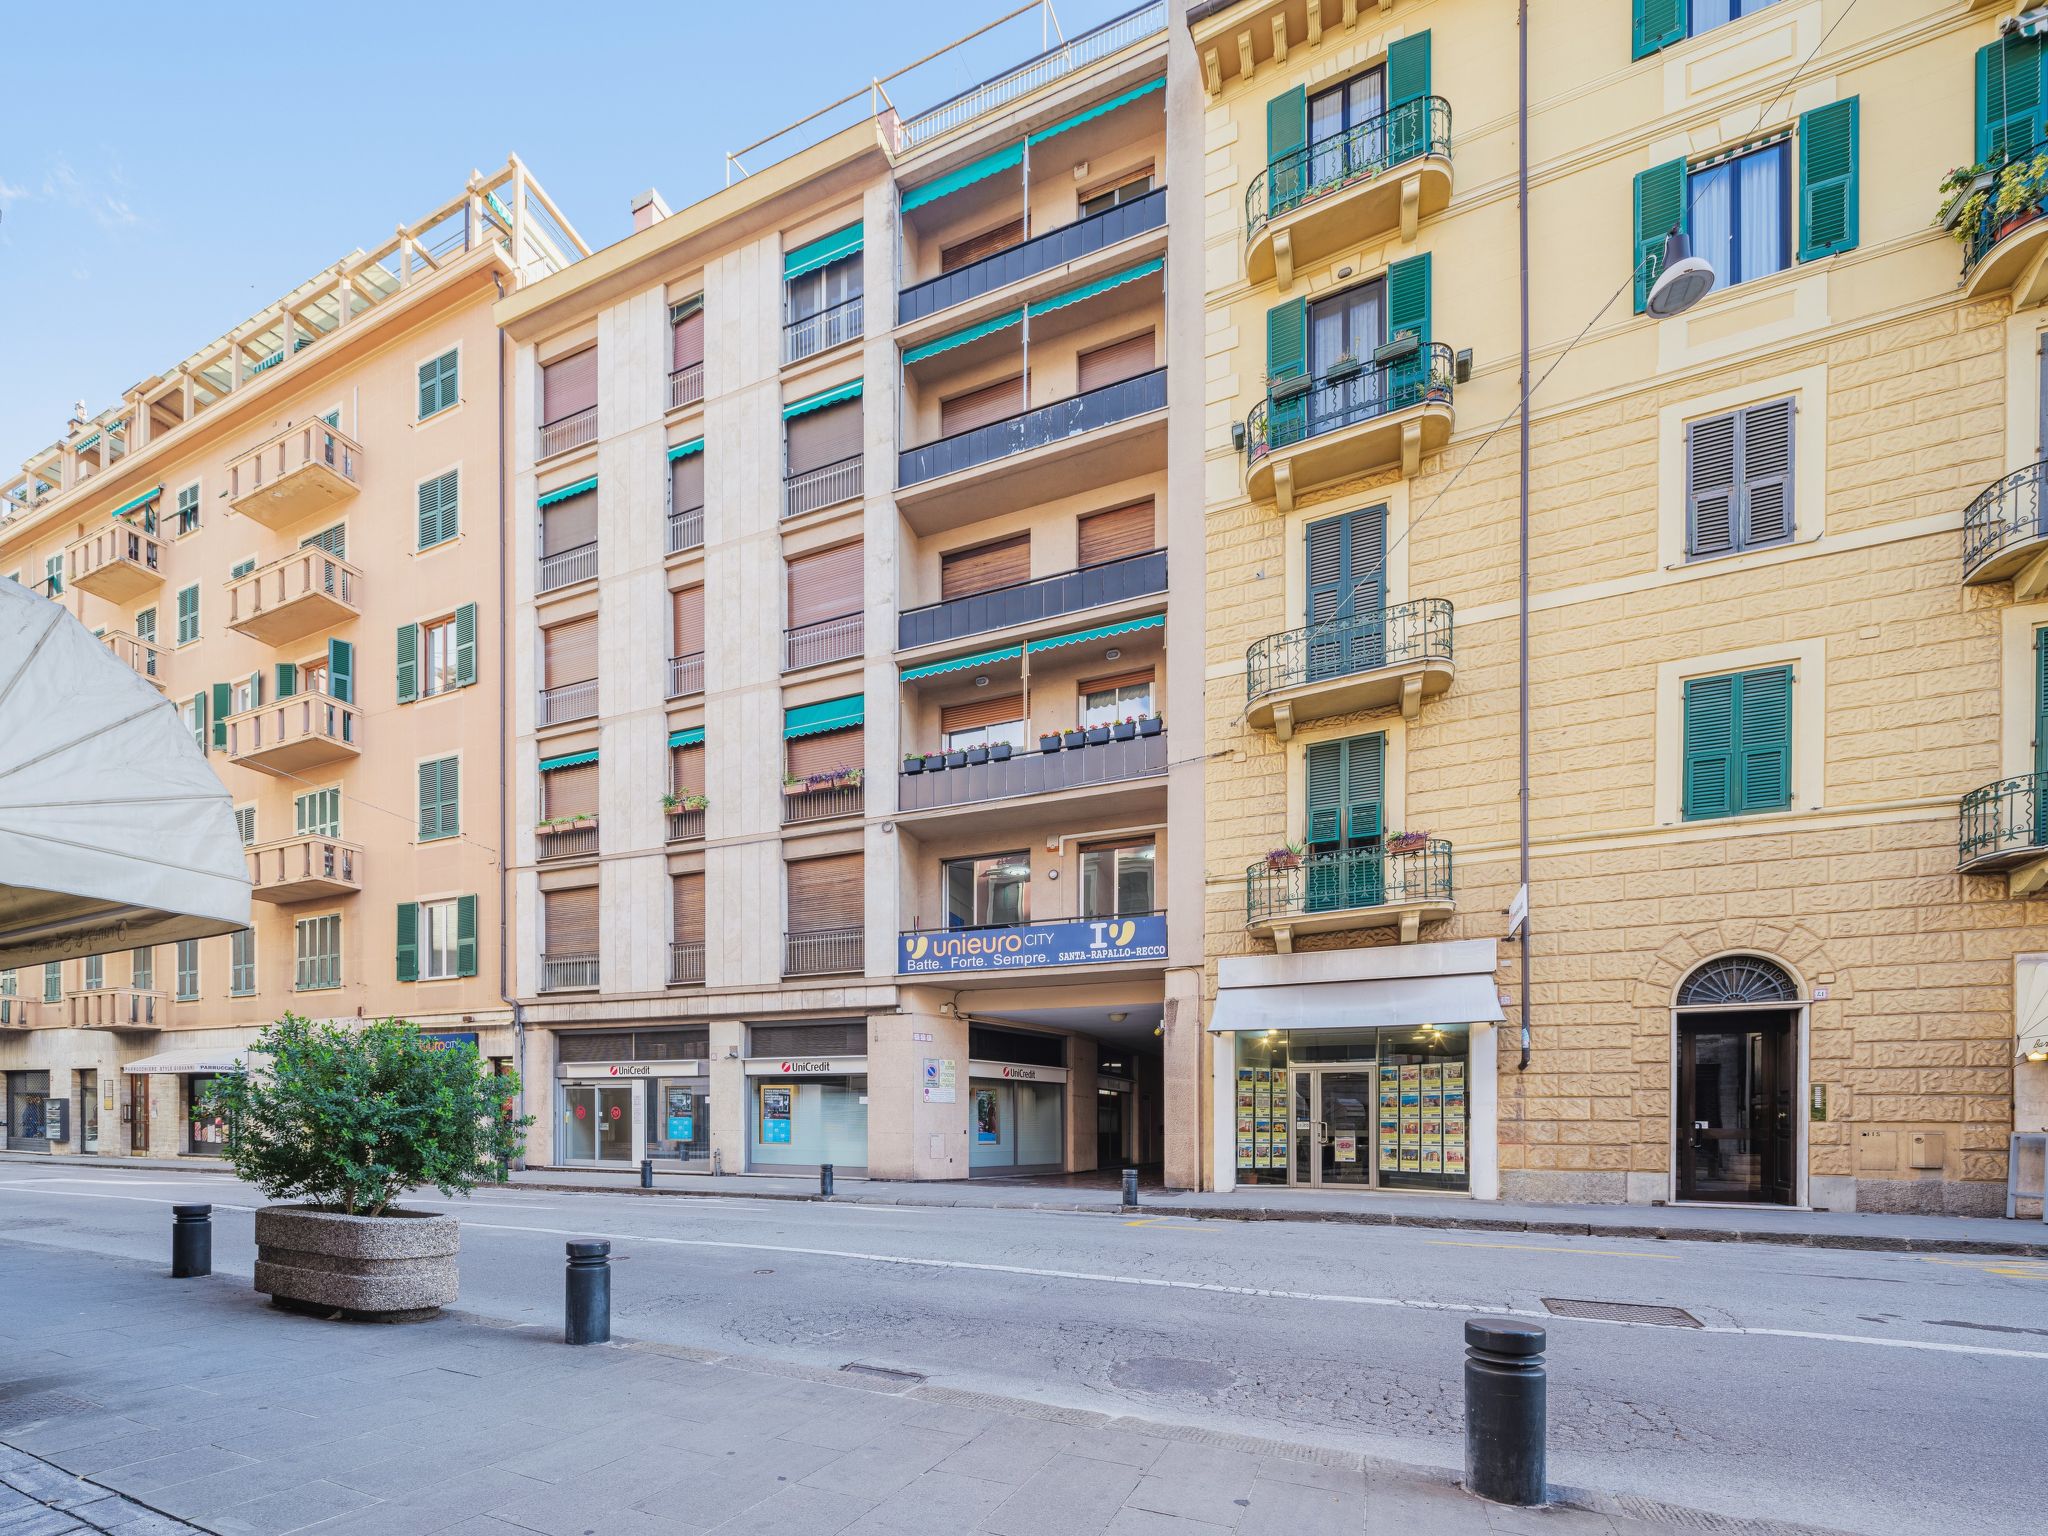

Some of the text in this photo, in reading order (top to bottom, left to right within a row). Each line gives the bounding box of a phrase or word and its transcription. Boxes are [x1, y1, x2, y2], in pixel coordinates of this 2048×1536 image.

[933, 932, 1055, 957] unieuro CITY
[1058, 945, 1166, 962] SANTA-RAPALLO-RECCO
[907, 953, 1050, 971] Batte. Forte. Sempre.
[618, 1065, 650, 1075] UniCredit
[792, 1061, 830, 1072] UniCredit
[1010, 1068, 1036, 1079] UniCredit
